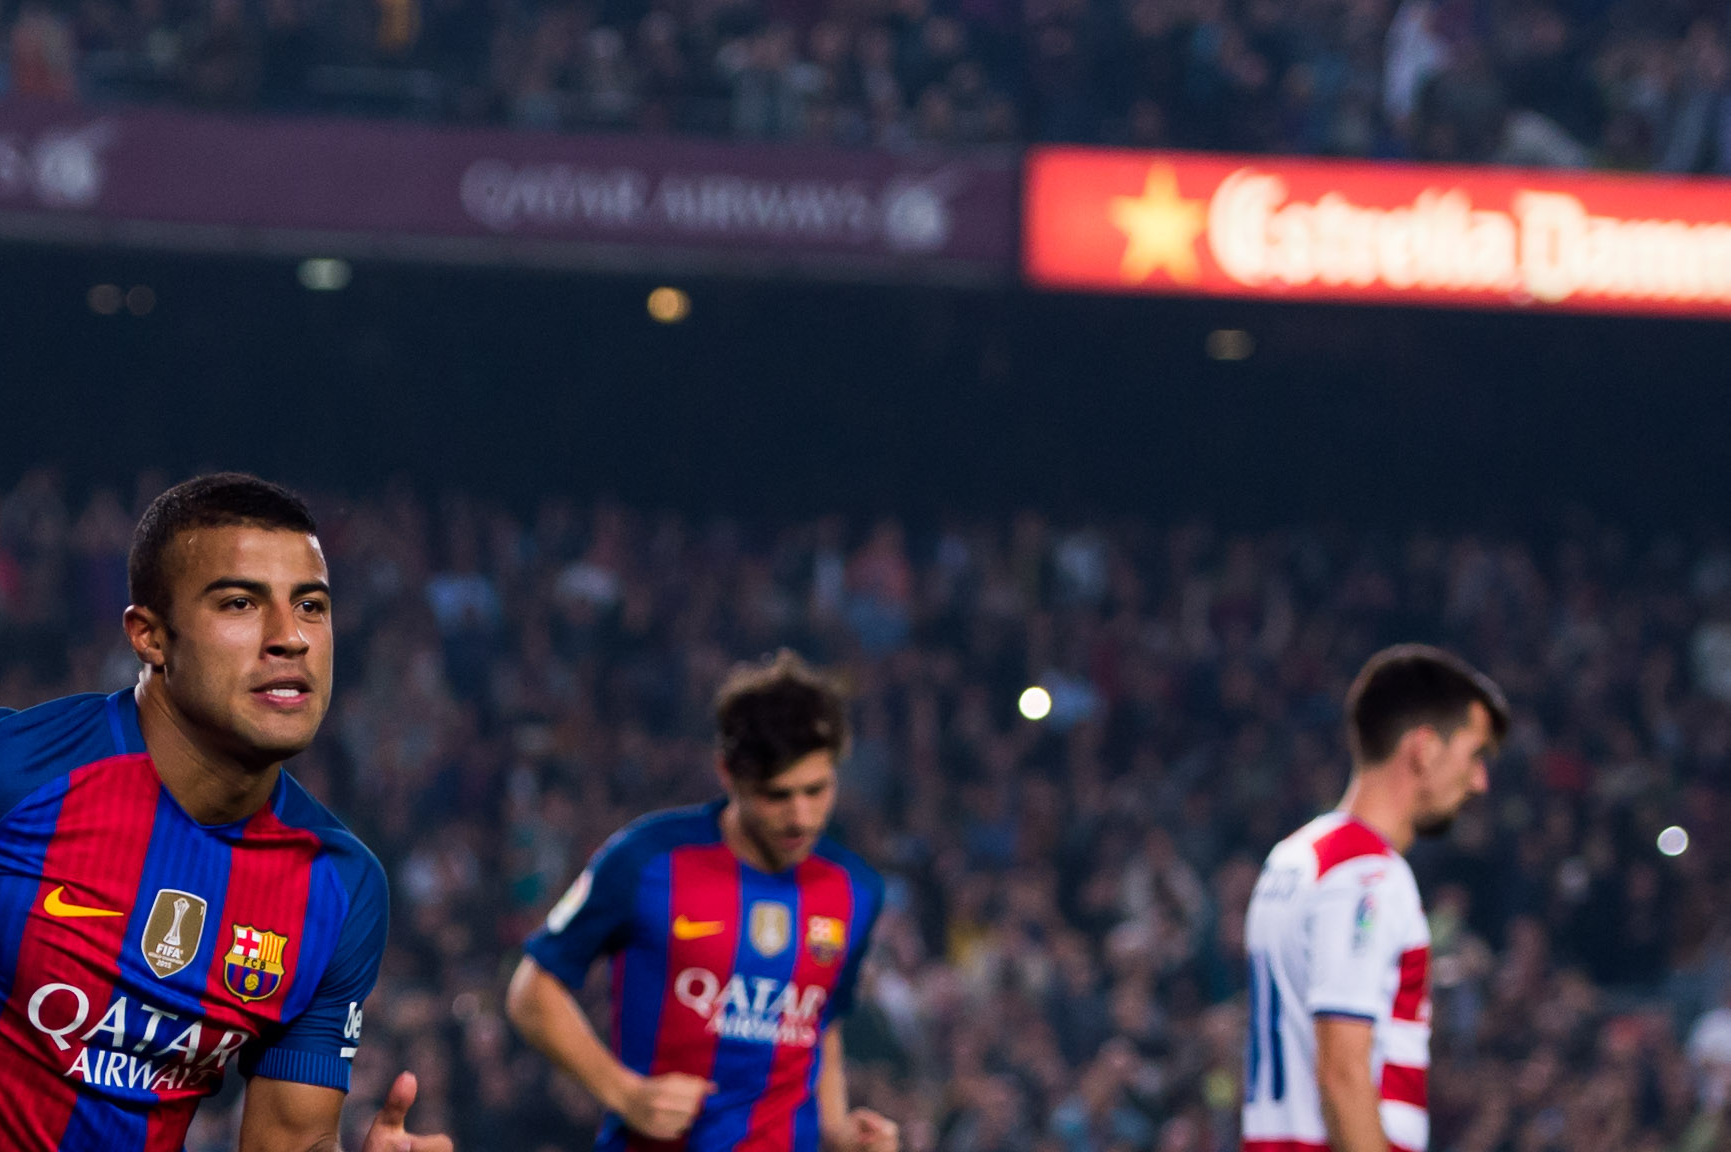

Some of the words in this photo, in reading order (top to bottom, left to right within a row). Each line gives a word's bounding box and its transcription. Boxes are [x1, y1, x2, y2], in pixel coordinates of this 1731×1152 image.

[156, 943, 181, 960] FIFA
[674, 967, 827, 1021] QATAR
[28, 982, 250, 1068] QATAR
[63, 1046, 220, 1091] AIRWAYS
